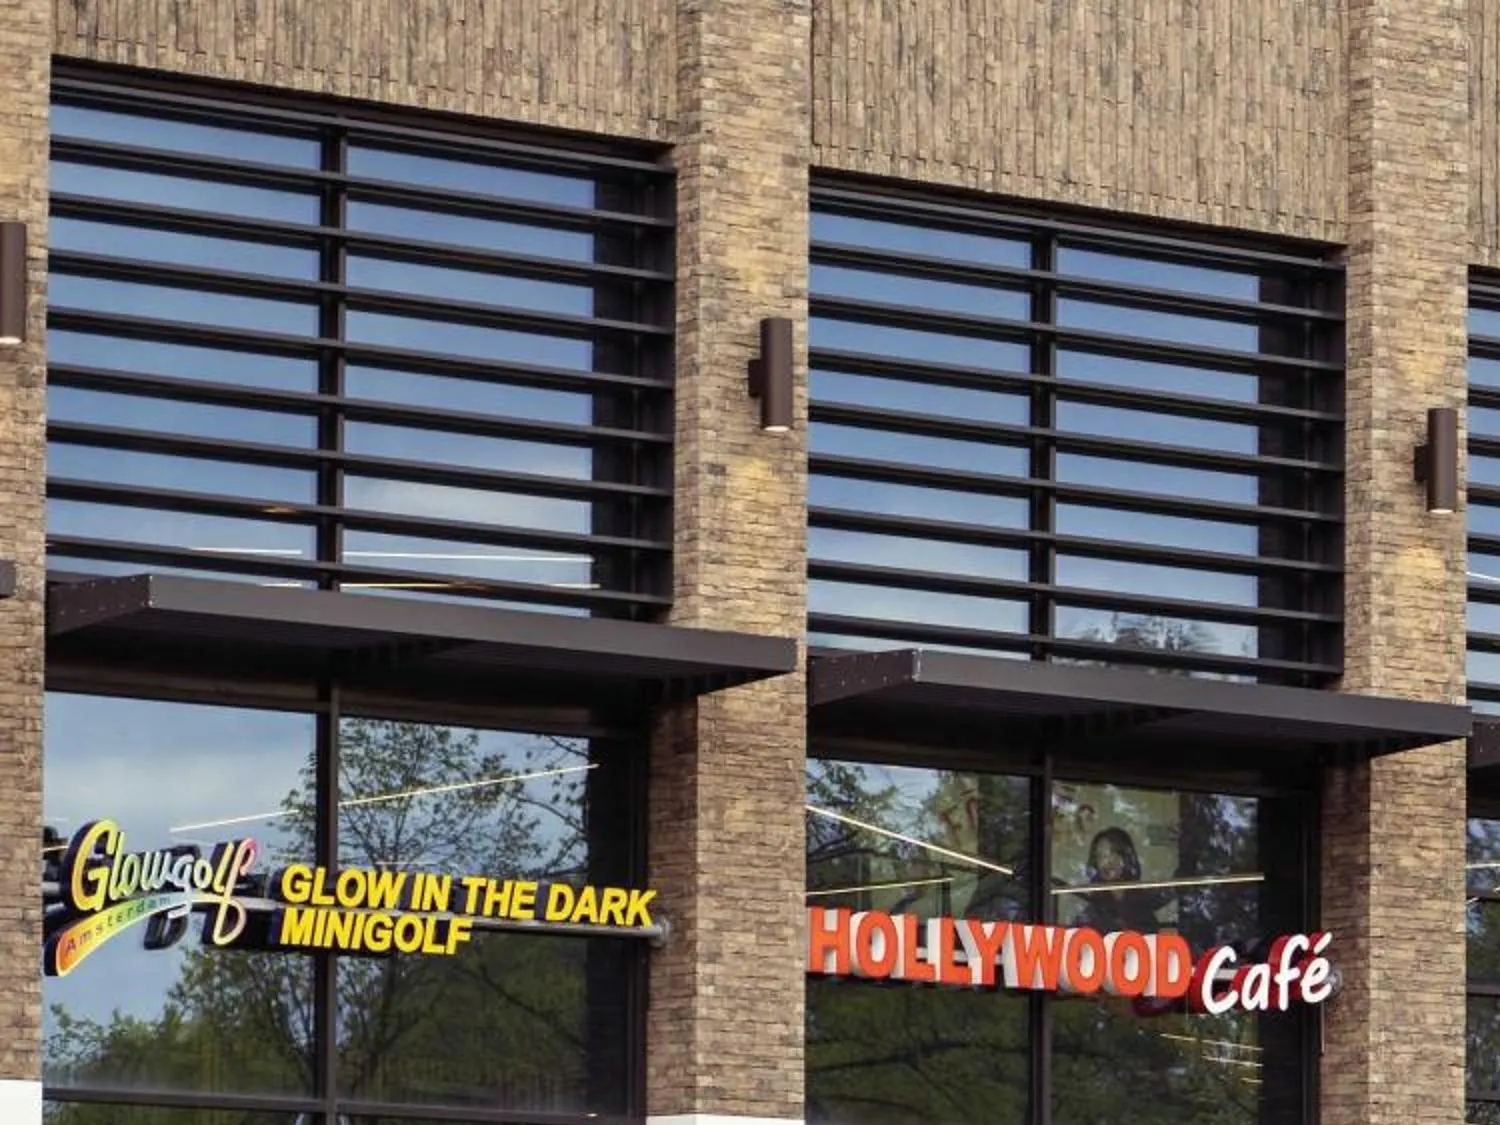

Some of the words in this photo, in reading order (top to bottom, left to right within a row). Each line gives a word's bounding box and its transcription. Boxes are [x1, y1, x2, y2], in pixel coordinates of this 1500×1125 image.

[71, 820, 257, 945] Glowgolf
[281, 864, 406, 909] GLOW
[411, 873, 451, 911] IN
[462, 877, 538, 919] THE
[546, 883, 656, 928] DARK
[280, 907, 473, 954] MINIGOLF
[807, 906, 1193, 998] HOLLYWOOD
[1201, 932, 1334, 1014] Café
